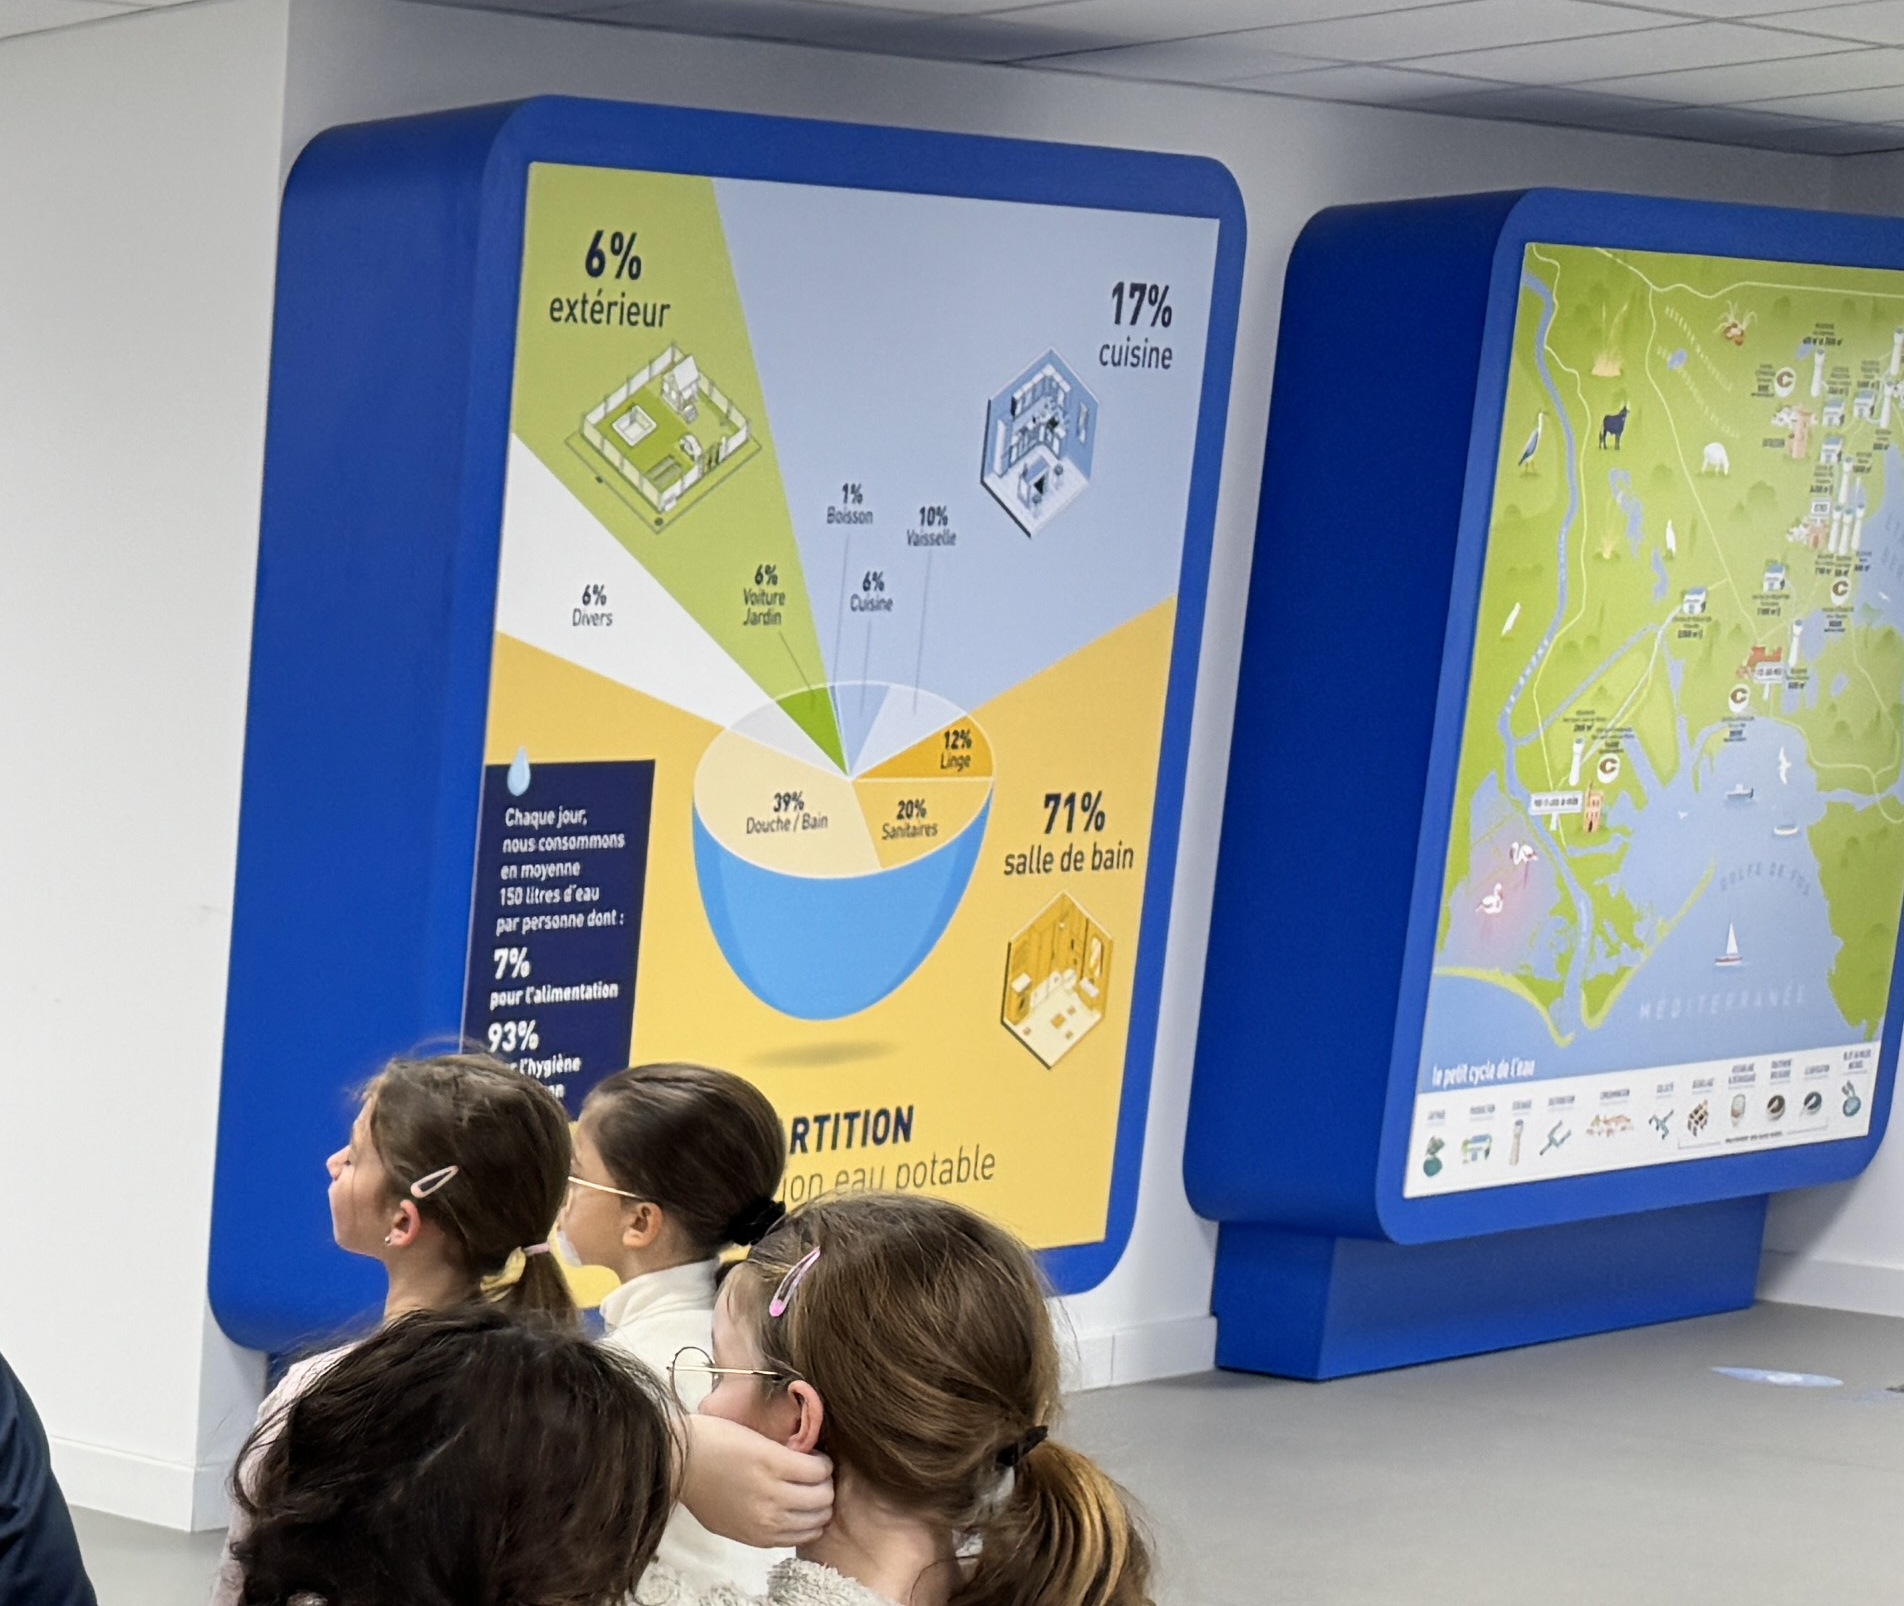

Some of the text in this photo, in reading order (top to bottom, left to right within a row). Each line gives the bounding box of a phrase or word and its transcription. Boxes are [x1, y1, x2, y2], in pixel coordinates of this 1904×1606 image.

[585, 229, 642, 280] 6%
[549, 288, 671, 328] extérieur
[1111, 281, 1172, 328] 17%
[1099, 335, 1173, 370] cuisine
[842, 483, 863, 504] 1%
[826, 506, 874, 525] Boisson
[919, 505, 949, 527] 10%
[906, 528, 957, 547] Vaisselle
[754, 564, 778, 586] 6%
[862, 570, 885, 592] 6%
[581, 584, 607, 606] 6%
[743, 587, 786, 607] Voiture
[850, 593, 894, 612] Cuisine
[572, 608, 613, 627] Divers
[743, 607, 782, 627] Jardin
[944, 729, 973, 750] 12%
[940, 751, 971, 772] Linge
[773, 791, 805, 813] 39%
[896, 799, 927, 820] 20%
[1044, 790, 1105, 834] 71%
[505, 805, 588, 830] Chaque jour,
[746, 816, 792, 834] Douche
[802, 811, 828, 830] Bain
[882, 820, 938, 840] Sanitaires
[502, 833, 626, 853] nous consommons
[1004, 840, 1134, 875] salle de bain
[500, 862, 581, 881] en moyenne
[500, 884, 600, 906] 150 litres d'eau
[496, 917, 520, 937] par
[522, 913, 584, 935] personne
[587, 908, 617, 927] dont
[494, 947, 531, 980] 7%
[490, 981, 619, 1011] pour l'alimentation
[488, 1019, 539, 1052] 93%
[520, 1053, 582, 1079] l'hygiène
[789, 1105, 914, 1155] RTITION
[896, 1143, 996, 1190] potable
